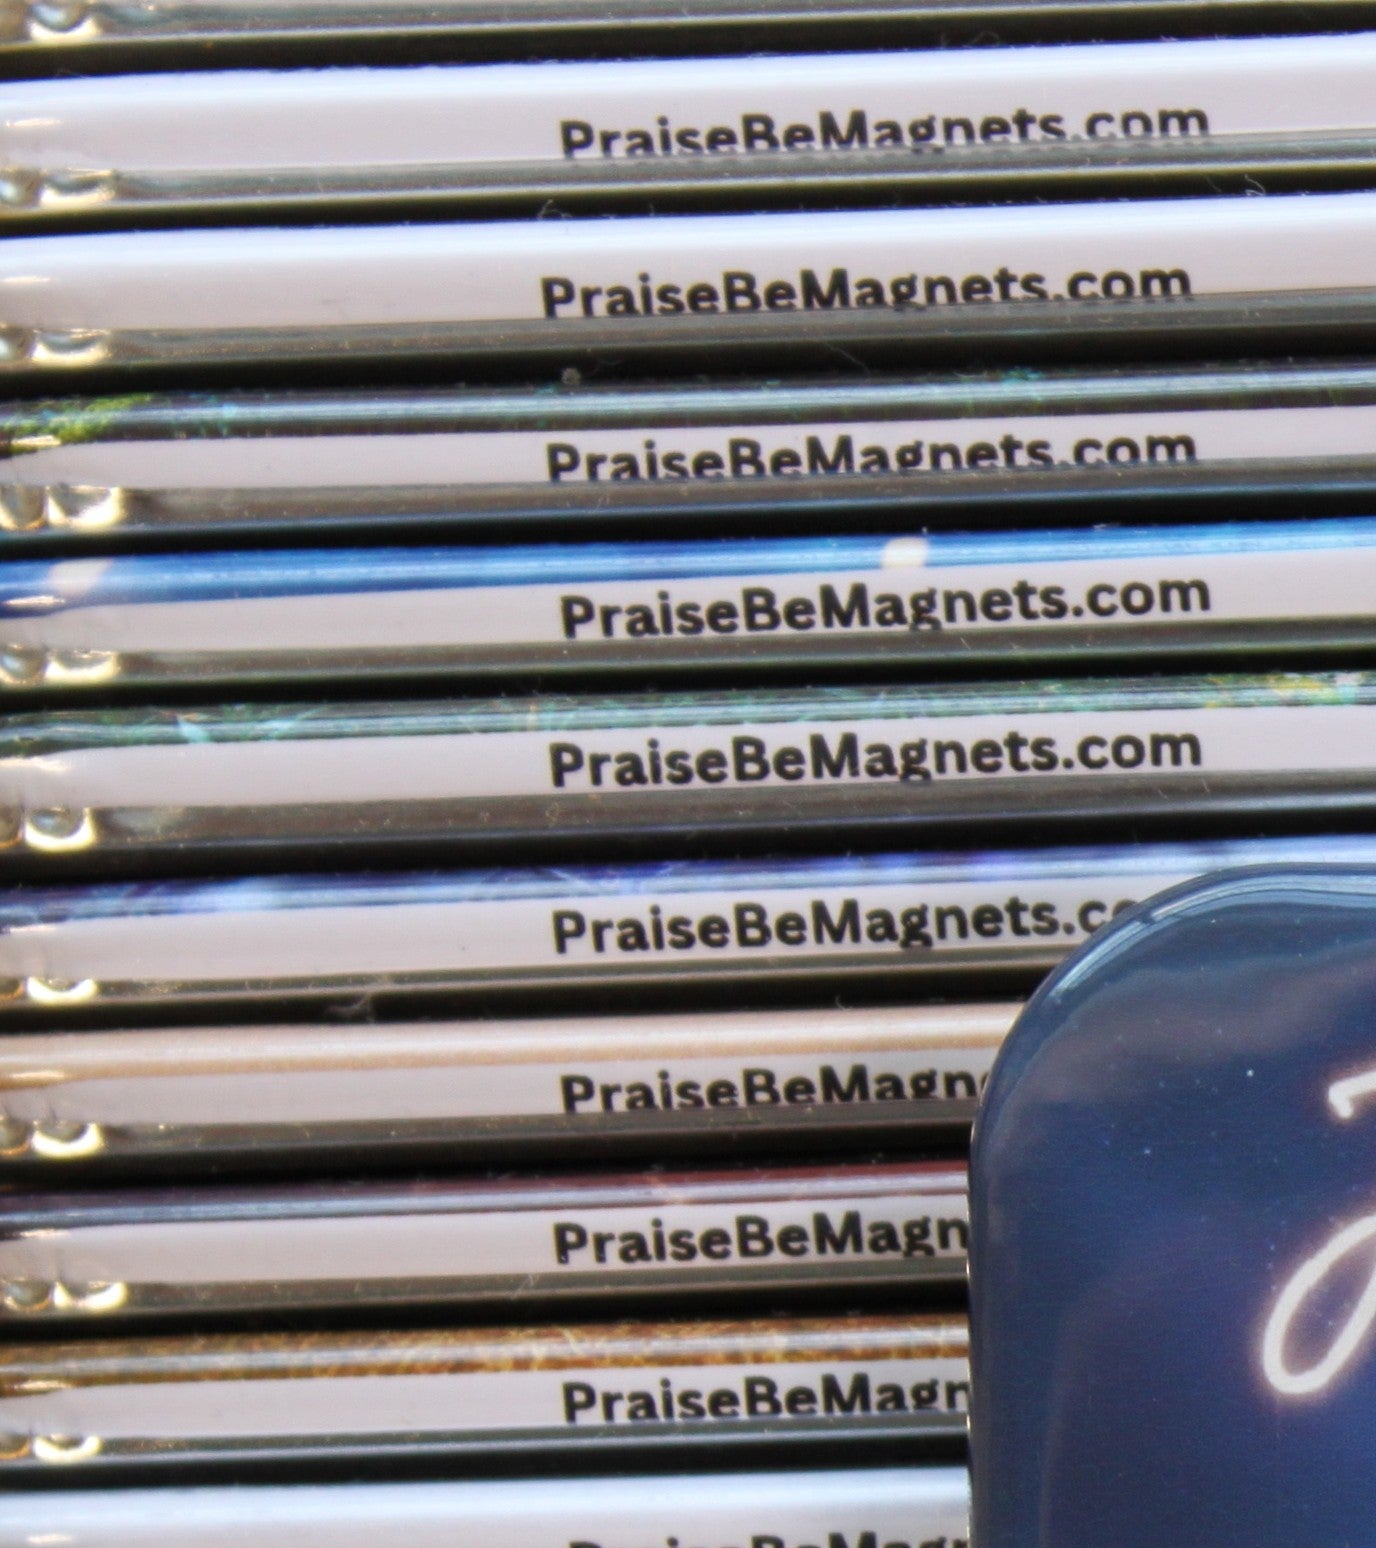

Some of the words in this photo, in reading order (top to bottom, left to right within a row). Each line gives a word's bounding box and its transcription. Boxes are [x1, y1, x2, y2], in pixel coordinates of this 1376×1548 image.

[540, 264, 1192, 320] PraiseBeMagnets.com
[561, 575, 1211, 640] PraiseBeMagnets.com
[550, 730, 1202, 787] PraiseBeMagnets.com
[553, 894, 1132, 955] PraiseBeMagnets.c
[560, 1064, 988, 1114] PraiseBeMagn
[554, 1210, 968, 1265] PraiseBeMagn
[561, 1365, 969, 1424] PraiseBeMagn
